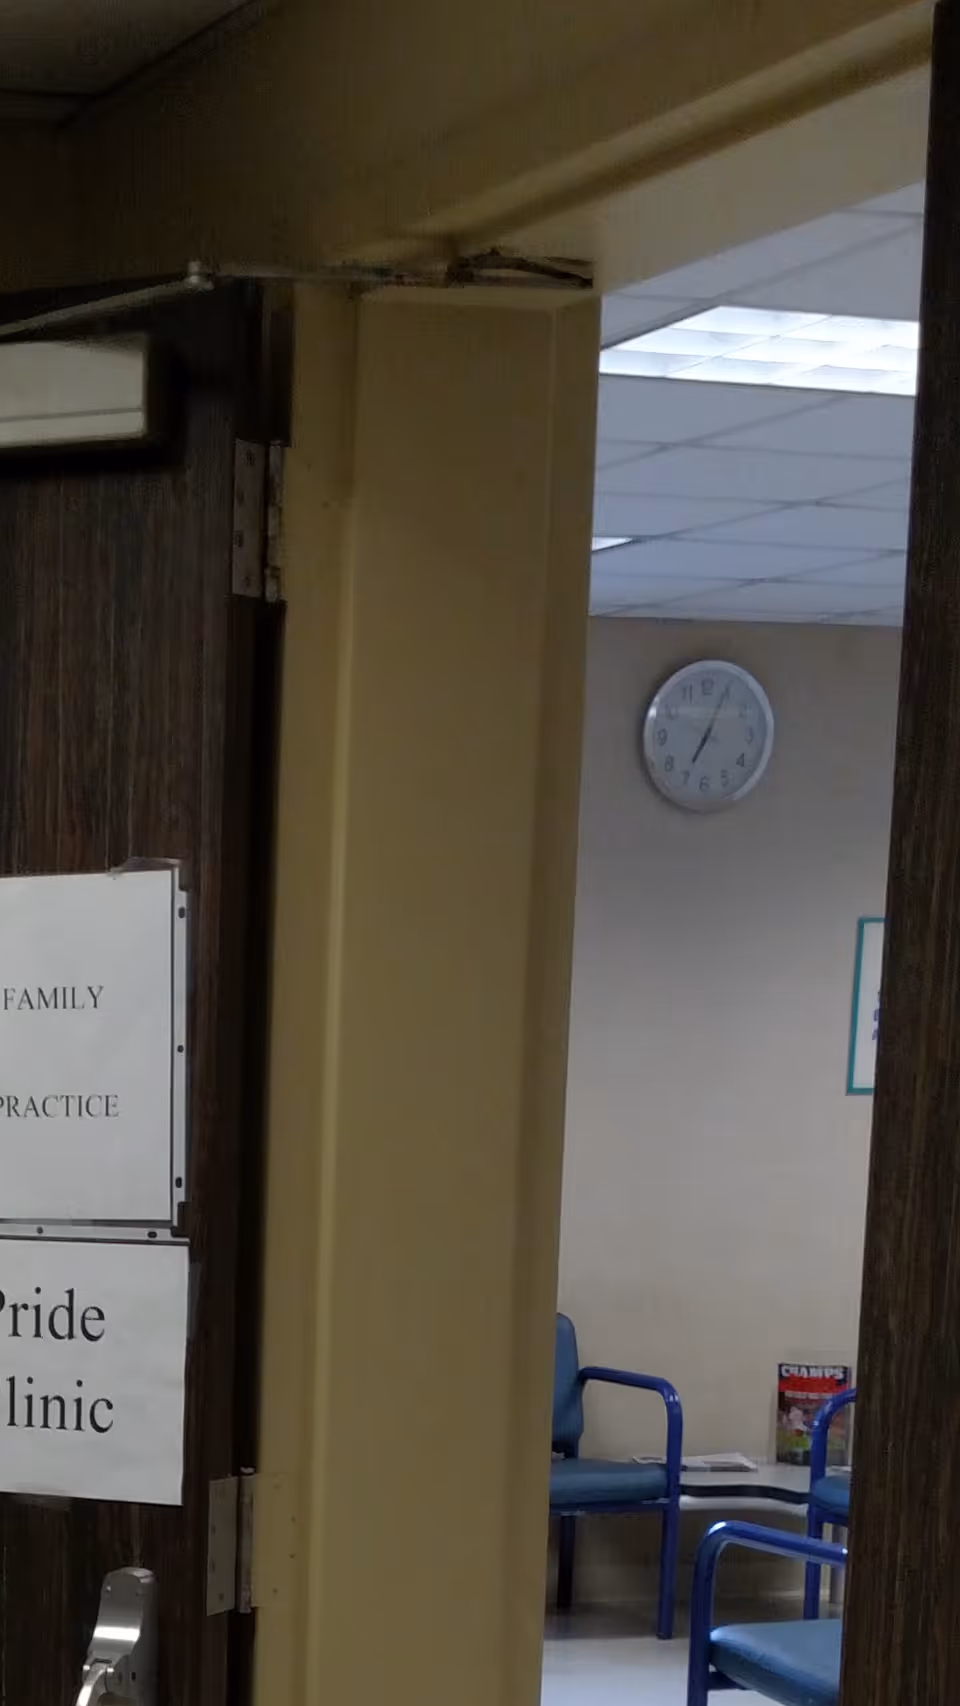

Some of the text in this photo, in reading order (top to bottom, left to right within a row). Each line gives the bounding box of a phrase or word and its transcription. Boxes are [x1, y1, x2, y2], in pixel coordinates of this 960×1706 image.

[735, 752, 746, 769] 4
[2, 984, 106, 1011] FAMILY
[781, 1365, 845, 1380] CHAMPS
